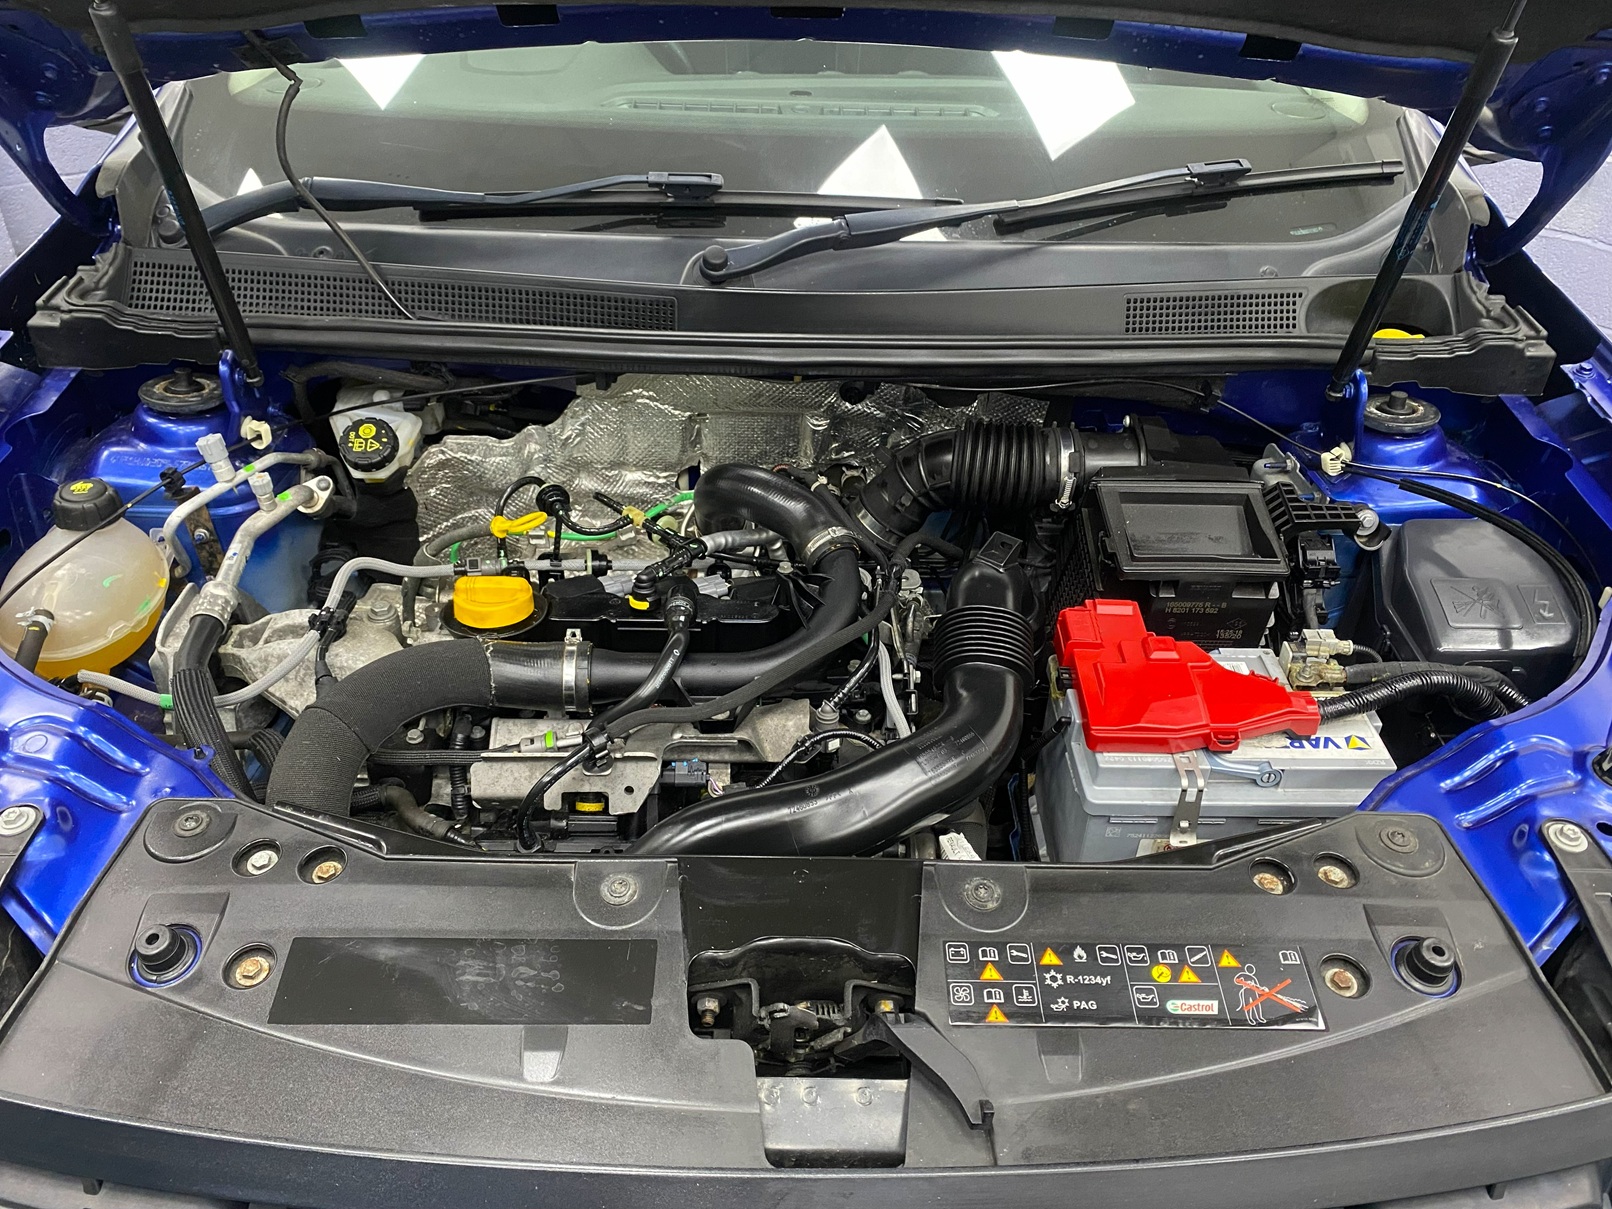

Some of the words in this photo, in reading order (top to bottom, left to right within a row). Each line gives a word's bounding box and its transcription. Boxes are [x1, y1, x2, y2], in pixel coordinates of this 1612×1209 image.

[1066, 975, 1111, 986] R-1234yf
[1073, 1000, 1098, 1010] PAG
[1180, 1002, 1215, 1012] Castrol
